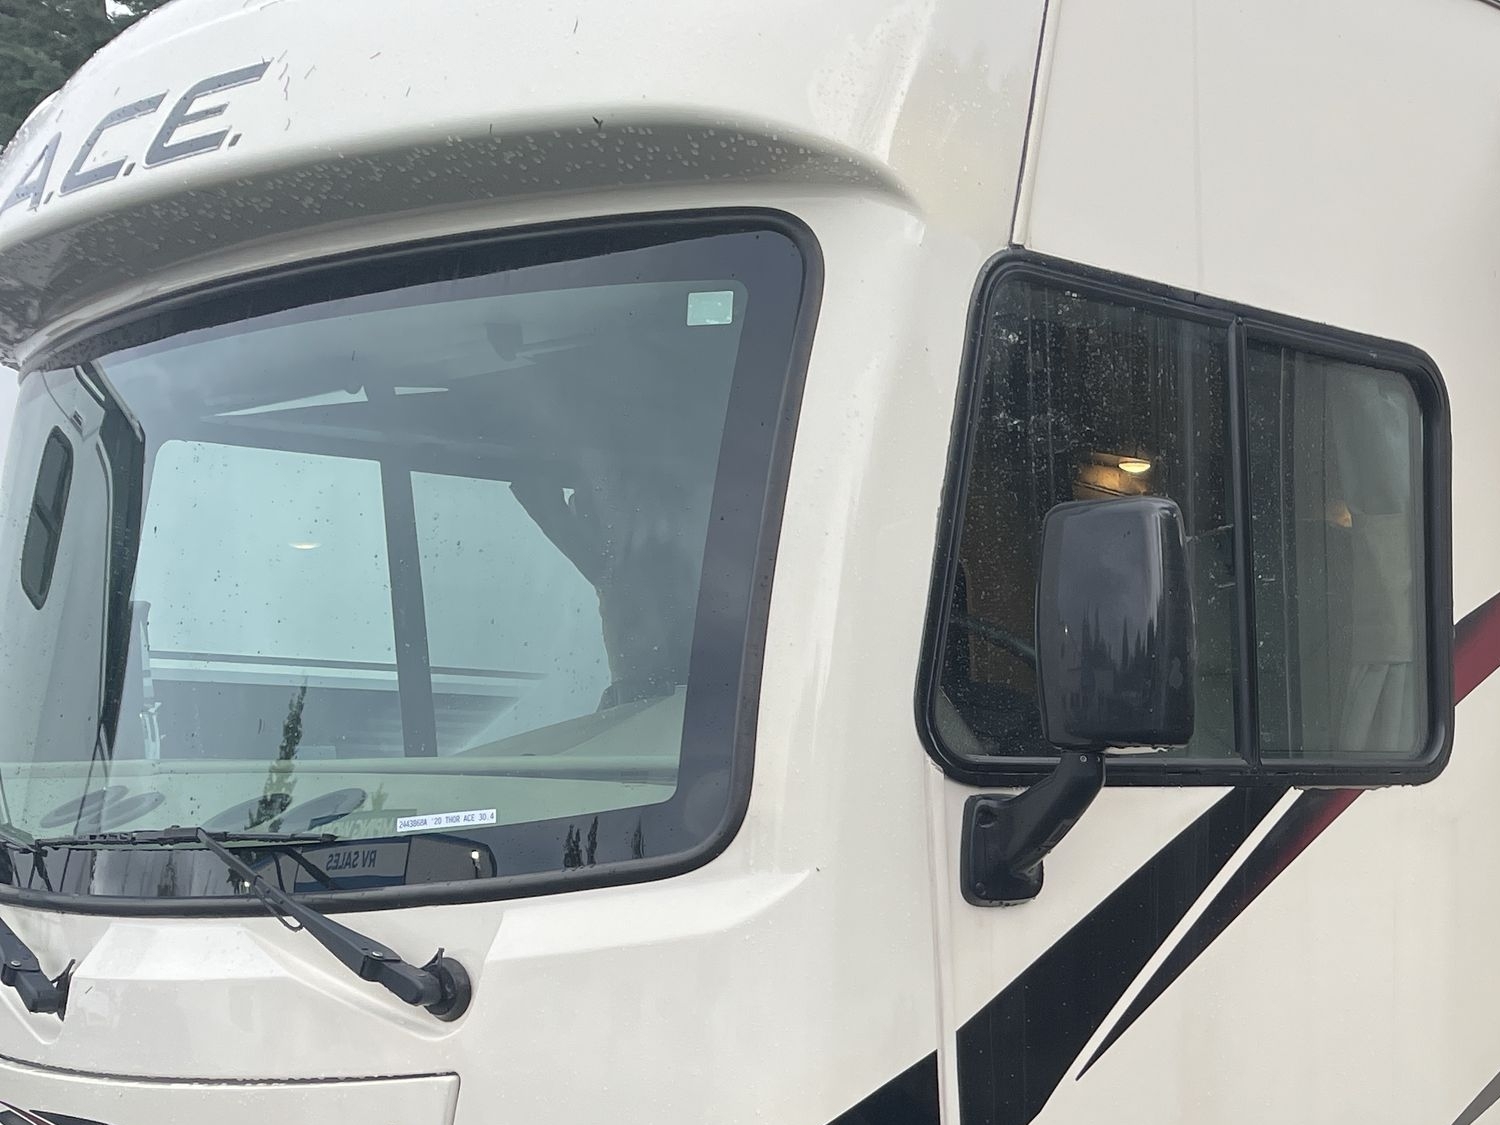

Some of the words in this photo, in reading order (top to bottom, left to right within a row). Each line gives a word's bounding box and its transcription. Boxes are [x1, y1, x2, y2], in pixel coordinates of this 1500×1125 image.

[0, 57, 274, 213] A.C.E.
[445, 815, 461, 824] THOR
[463, 813, 475, 822] ACE
